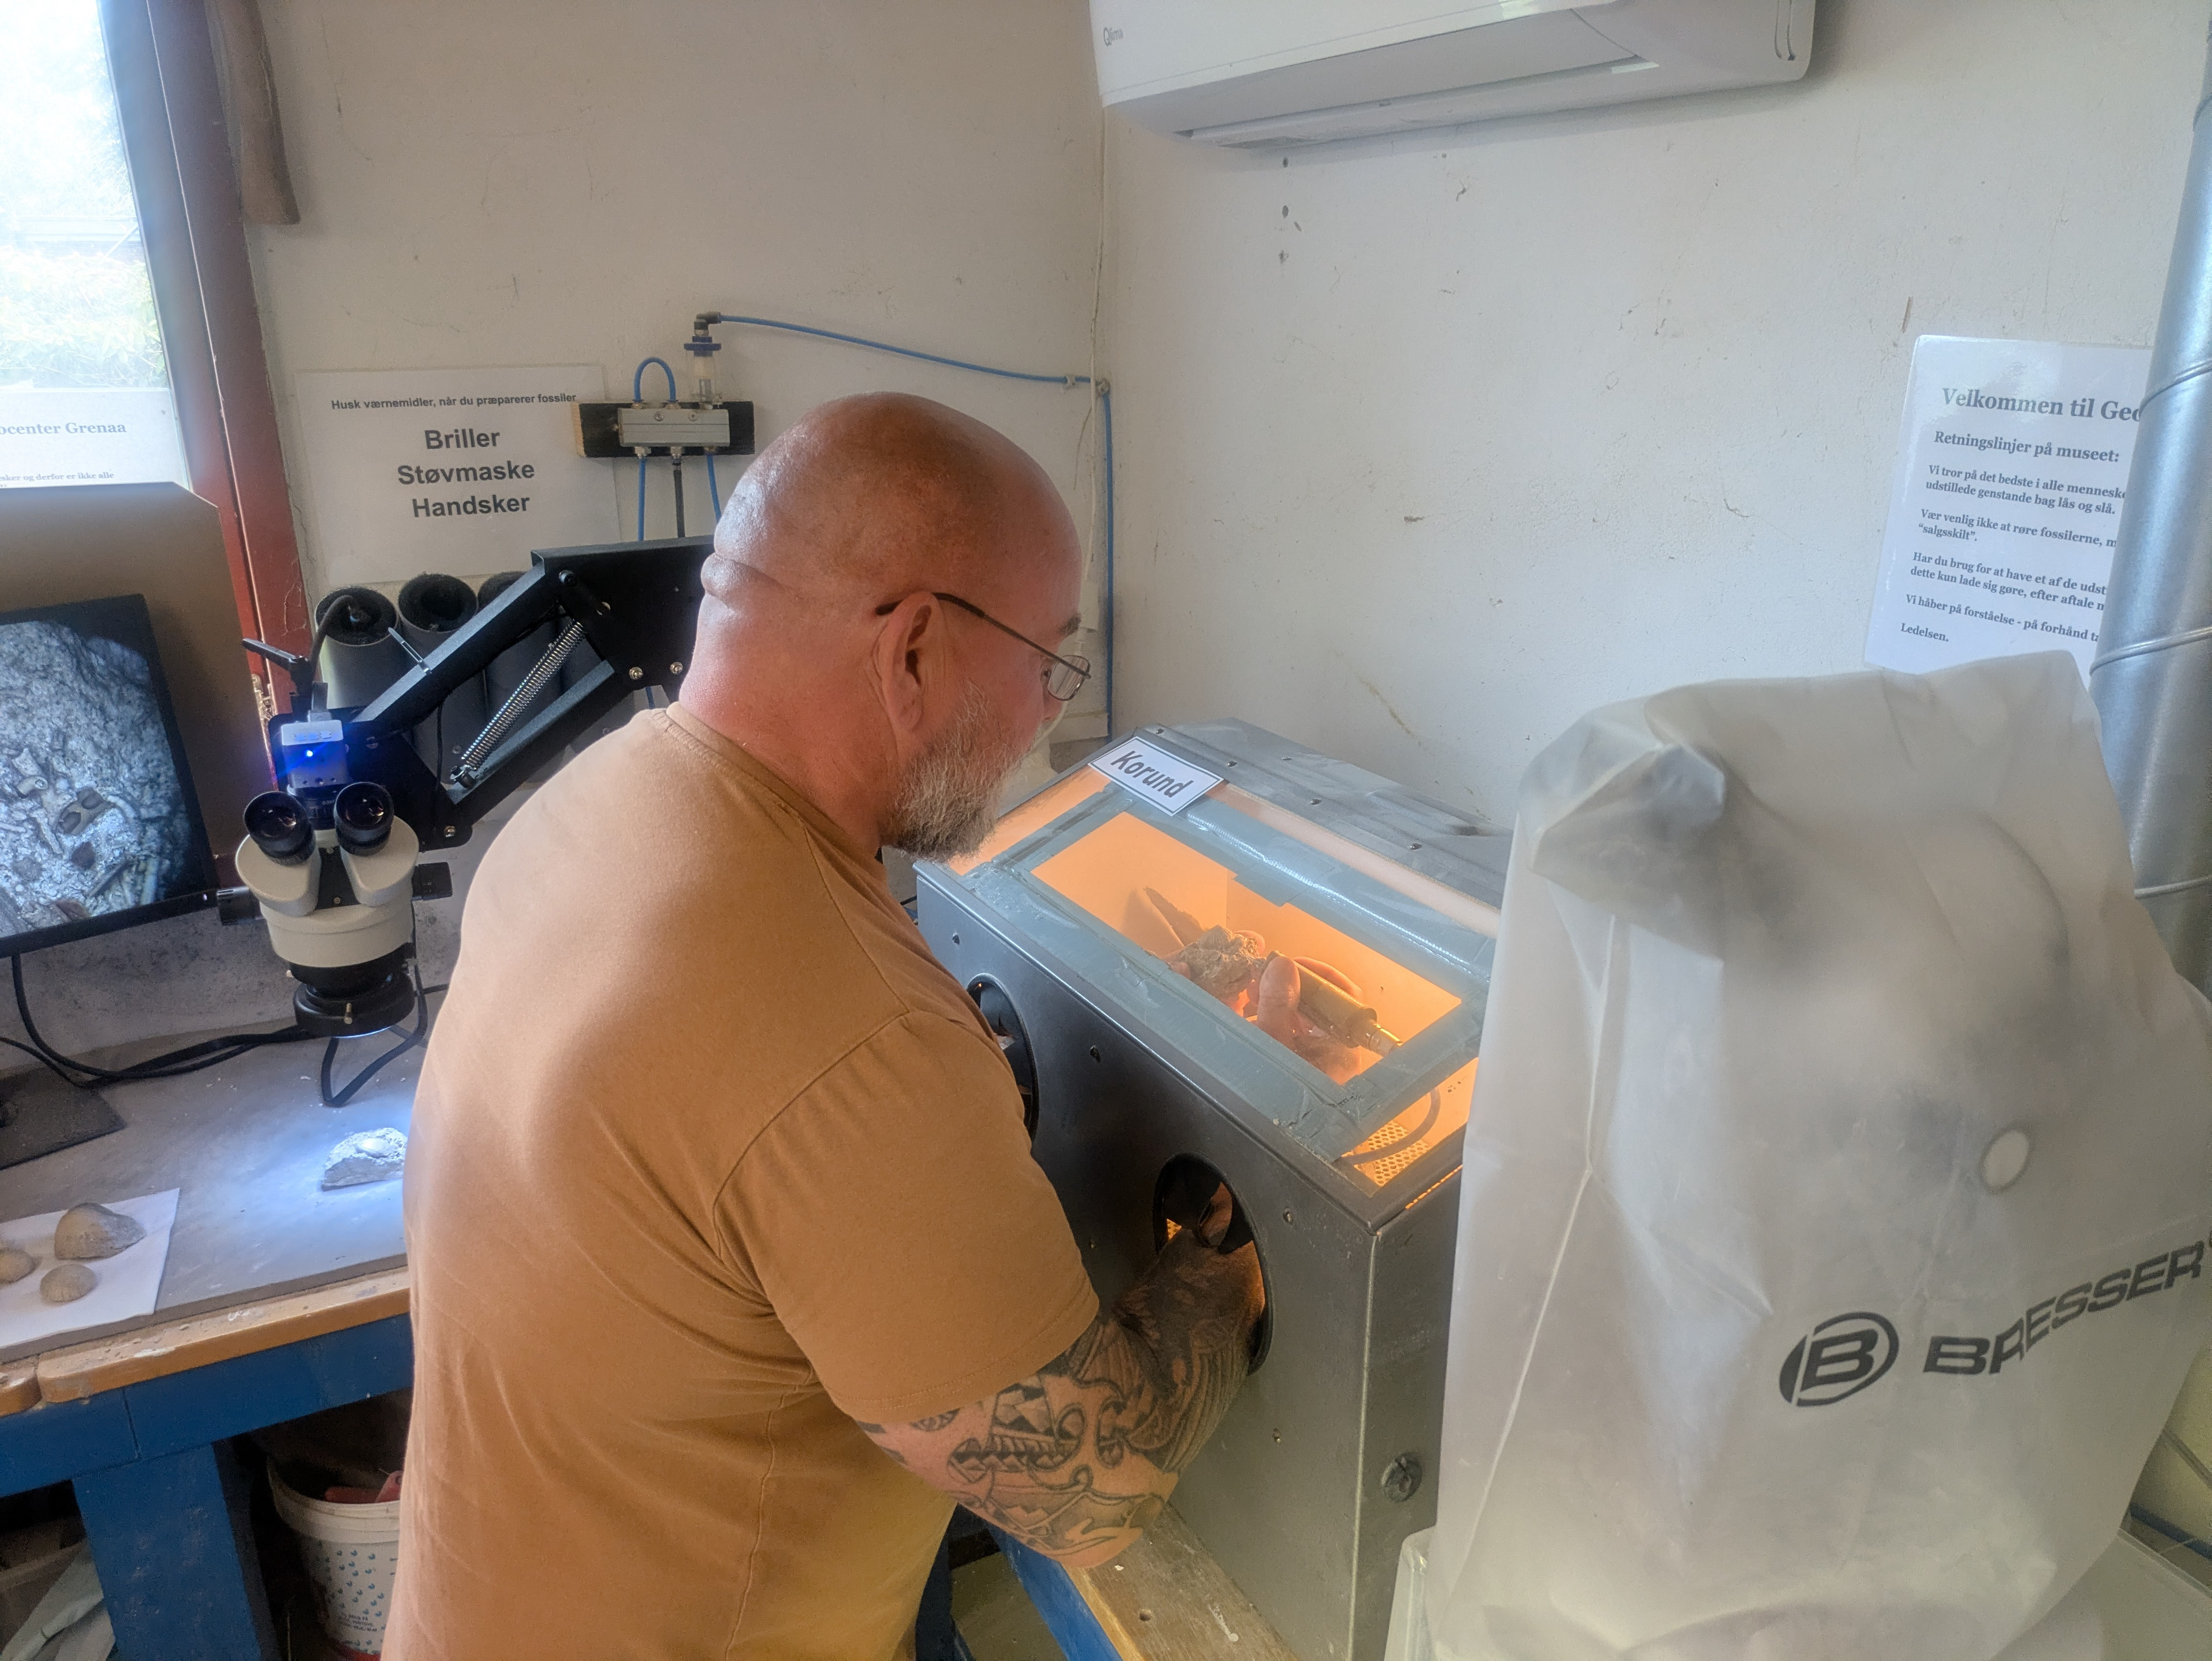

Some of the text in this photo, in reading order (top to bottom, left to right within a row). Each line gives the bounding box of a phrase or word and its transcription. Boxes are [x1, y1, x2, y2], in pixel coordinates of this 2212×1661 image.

[331, 393, 576, 410] Husk værnemidler, når du præparerer fossiler
[1942, 388, 2064, 415] Velkommen
[2069, 398, 2095, 418] til
[65, 422, 127, 433] Grenaa
[424, 429, 500, 449] Briller
[1934, 431, 2119, 463] Retningslinjer på museet:
[398, 460, 534, 485] Støvmaske
[1929, 465, 1940, 475] Vi
[1942, 467, 1963, 478] tror
[1963, 470, 1977, 481] på
[1980, 471, 1997, 483] det
[1998, 473, 2034, 487] bedste
[2035, 478, 2040, 488] i
[2042, 479, 2064, 491] alle
[412, 494, 530, 517] Handsker
[1926, 480, 2115, 514] udstillede genstande bag lås og slå.
[1921, 509, 1942, 520] Vær
[1944, 514, 1975, 528] venlig
[1976, 517, 1998, 530] ikke
[2000, 523, 2011, 532] at
[2013, 525, 2038, 536] røre
[2040, 526, 2102, 547] fossilerne,
[1913, 552, 1933, 563] Har
[1934, 555, 1948, 566] du
[1950, 557, 1975, 573] brug
[1976, 563, 1992, 574] for
[1993, 568, 2004, 577] at
[2005, 568, 2032, 582] have
[2035, 576, 2047, 584] et
[2048, 577, 2062, 587] af
[2063, 578, 2078, 589] de
[1911, 565, 1936, 579] dette
[1937, 570, 1957, 583] kun
[1958, 574, 1981, 587] lade
[1982, 580, 1998, 593] sig
[1999, 586, 2027, 598] gøre,
[2030, 589, 2059, 602] efter
[2060, 595, 2094, 609] aftale
[1901, 623, 1949, 642] Ledelsen.
[1906, 594, 1916, 604] Vi
[1918, 596, 1948, 610] håber
[1948, 604, 1961, 614] på
[1964, 606, 2014, 625] forståelse
[2023, 619, 2038, 630] på
[2040, 621, 2089, 640] forhånd
[1110, 751, 1193, 798] Korund
[1923, 1241, 2204, 1375] BRESSER
